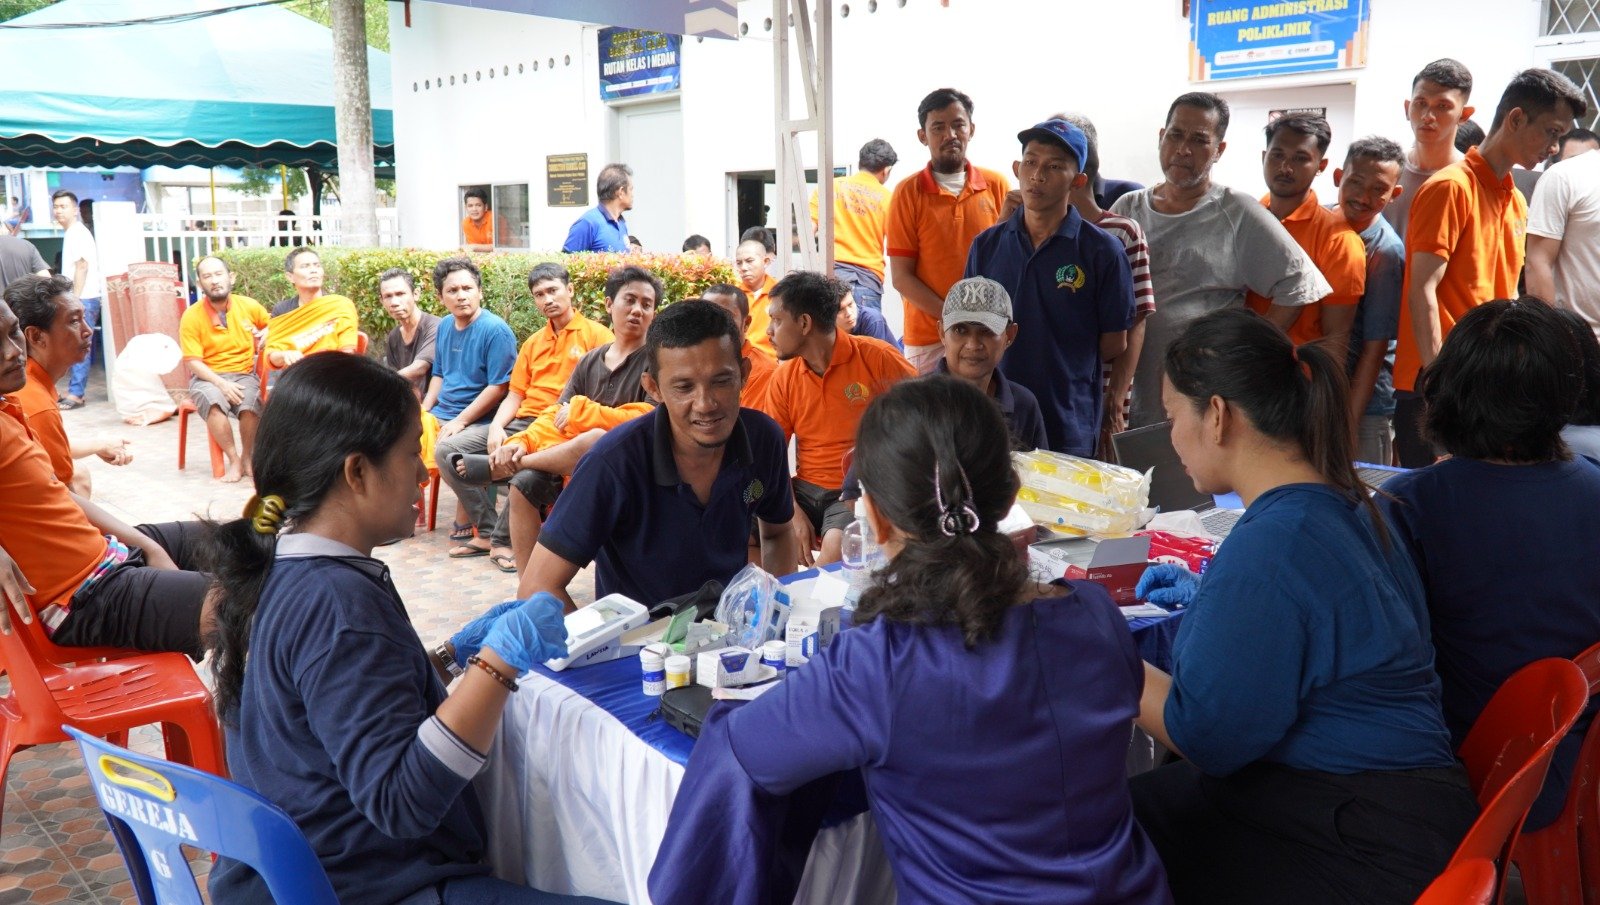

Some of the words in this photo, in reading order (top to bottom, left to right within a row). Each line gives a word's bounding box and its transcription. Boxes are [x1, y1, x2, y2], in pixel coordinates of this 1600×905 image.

[1207, 8, 1249, 26] RUANG
[1251, 0, 1349, 20] ADMINISTRASI
[1237, 21, 1312, 42] POLIKLINIK
[603, 60, 625, 76] RUTAN
[626, 55, 646, 73] KELAS
[647, 55, 650, 69] I
[651, 51, 676, 68] MEDAN
[101, 782, 199, 841] GEREJA
[151, 849, 172, 879] G
